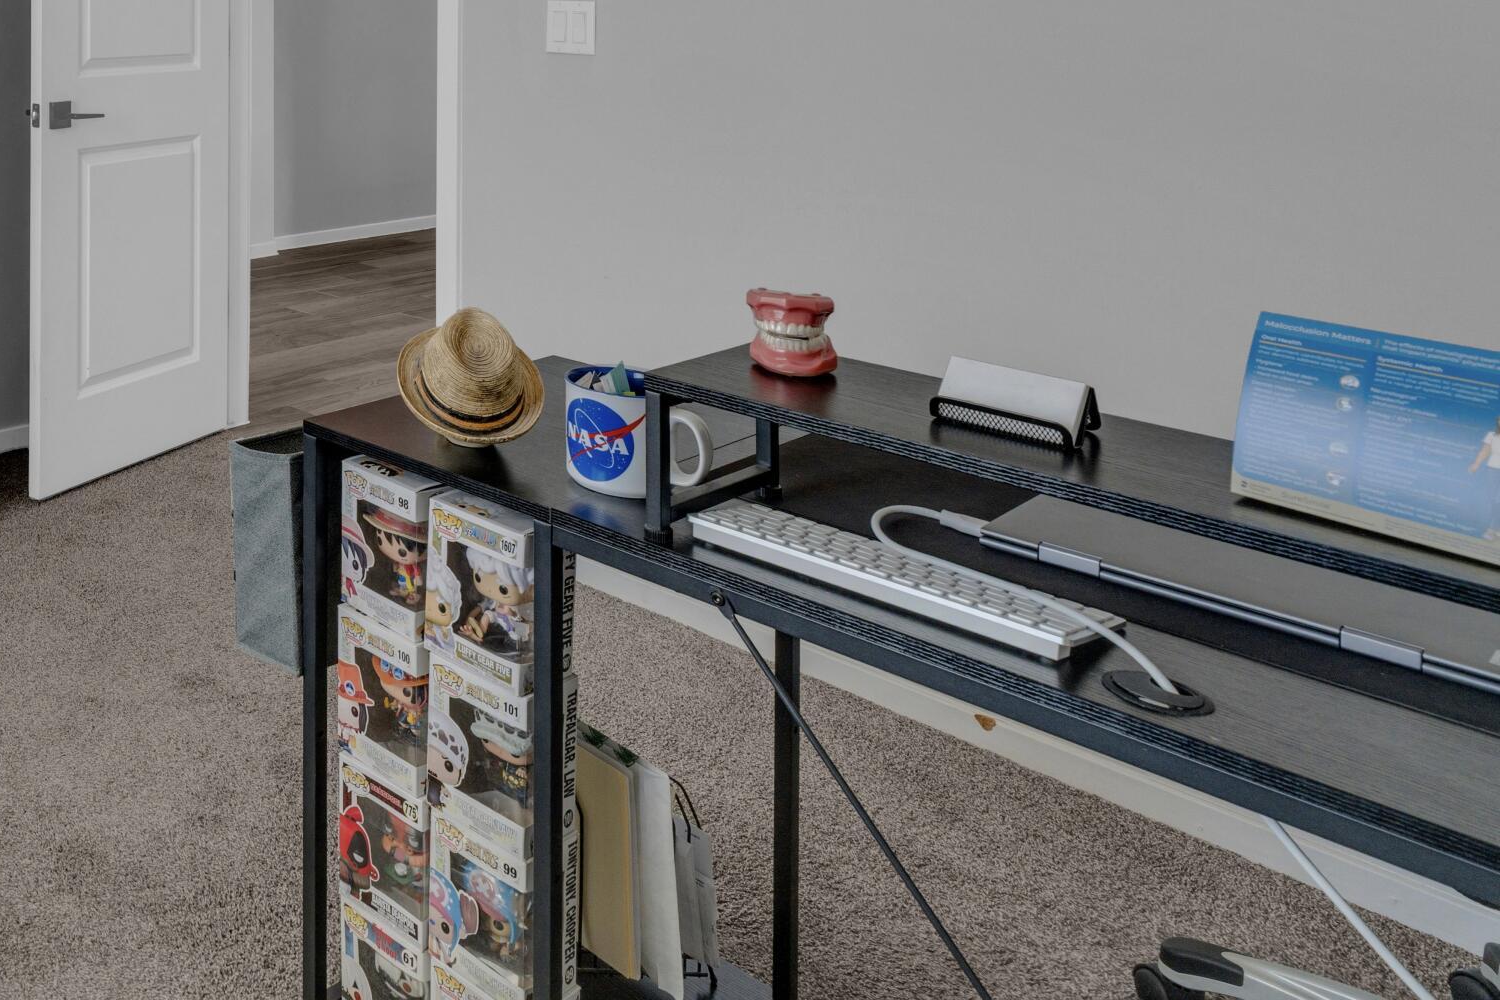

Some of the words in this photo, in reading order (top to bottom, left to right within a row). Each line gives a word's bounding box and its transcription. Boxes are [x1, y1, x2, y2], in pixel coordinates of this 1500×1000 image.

[1264, 319, 1330, 338] Malocclusion
[1331, 332, 1372, 346] Matters
[1277, 337, 1302, 345] Health
[1415, 362, 1443, 372] Health
[568, 421, 629, 455] NASA
[398, 497, 409, 510] 98
[432, 508, 462, 534] POP!
[501, 538, 516, 554] 1607
[563, 575, 575, 613] GEAR
[563, 619, 573, 649] FIVE
[398, 649, 411, 664] 100
[433, 664, 464, 690] POP!
[495, 663, 511, 677] FIVE
[503, 702, 519, 718] 101
[343, 765, 369, 792] POP!
[564, 770, 576, 799] LAW
[404, 802, 417, 820] 775
[503, 863, 518, 879] 99
[344, 904, 368, 934] POP!
[564, 906, 577, 964] CHOPPER
[403, 952, 415, 968] 61
[434, 966, 466, 998] POP!
